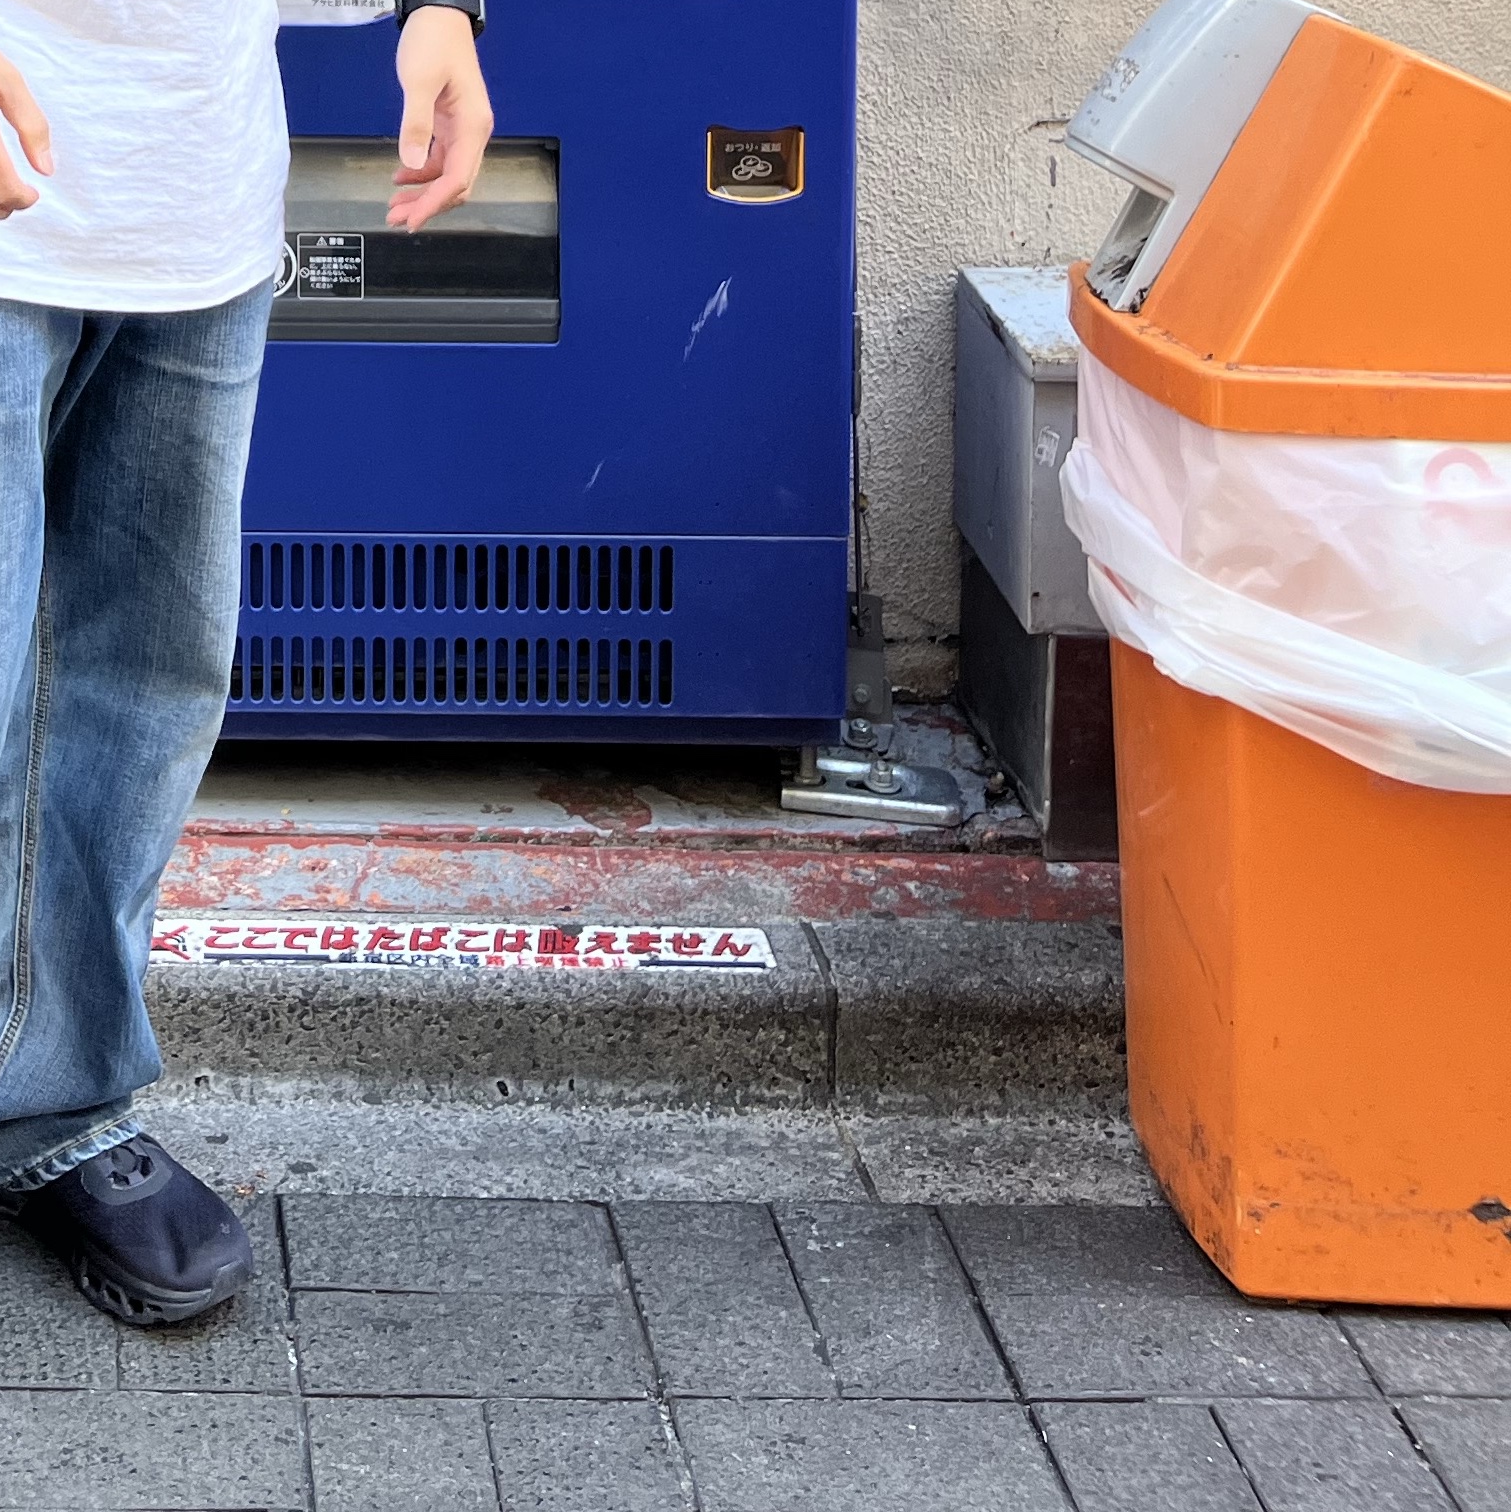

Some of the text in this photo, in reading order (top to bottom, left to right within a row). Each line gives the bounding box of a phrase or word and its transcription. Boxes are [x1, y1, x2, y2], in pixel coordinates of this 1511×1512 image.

[311, 0, 385, 8] アサヒ飲料株式会社
[203, 925, 753, 957] ここではたばこは吸えません
